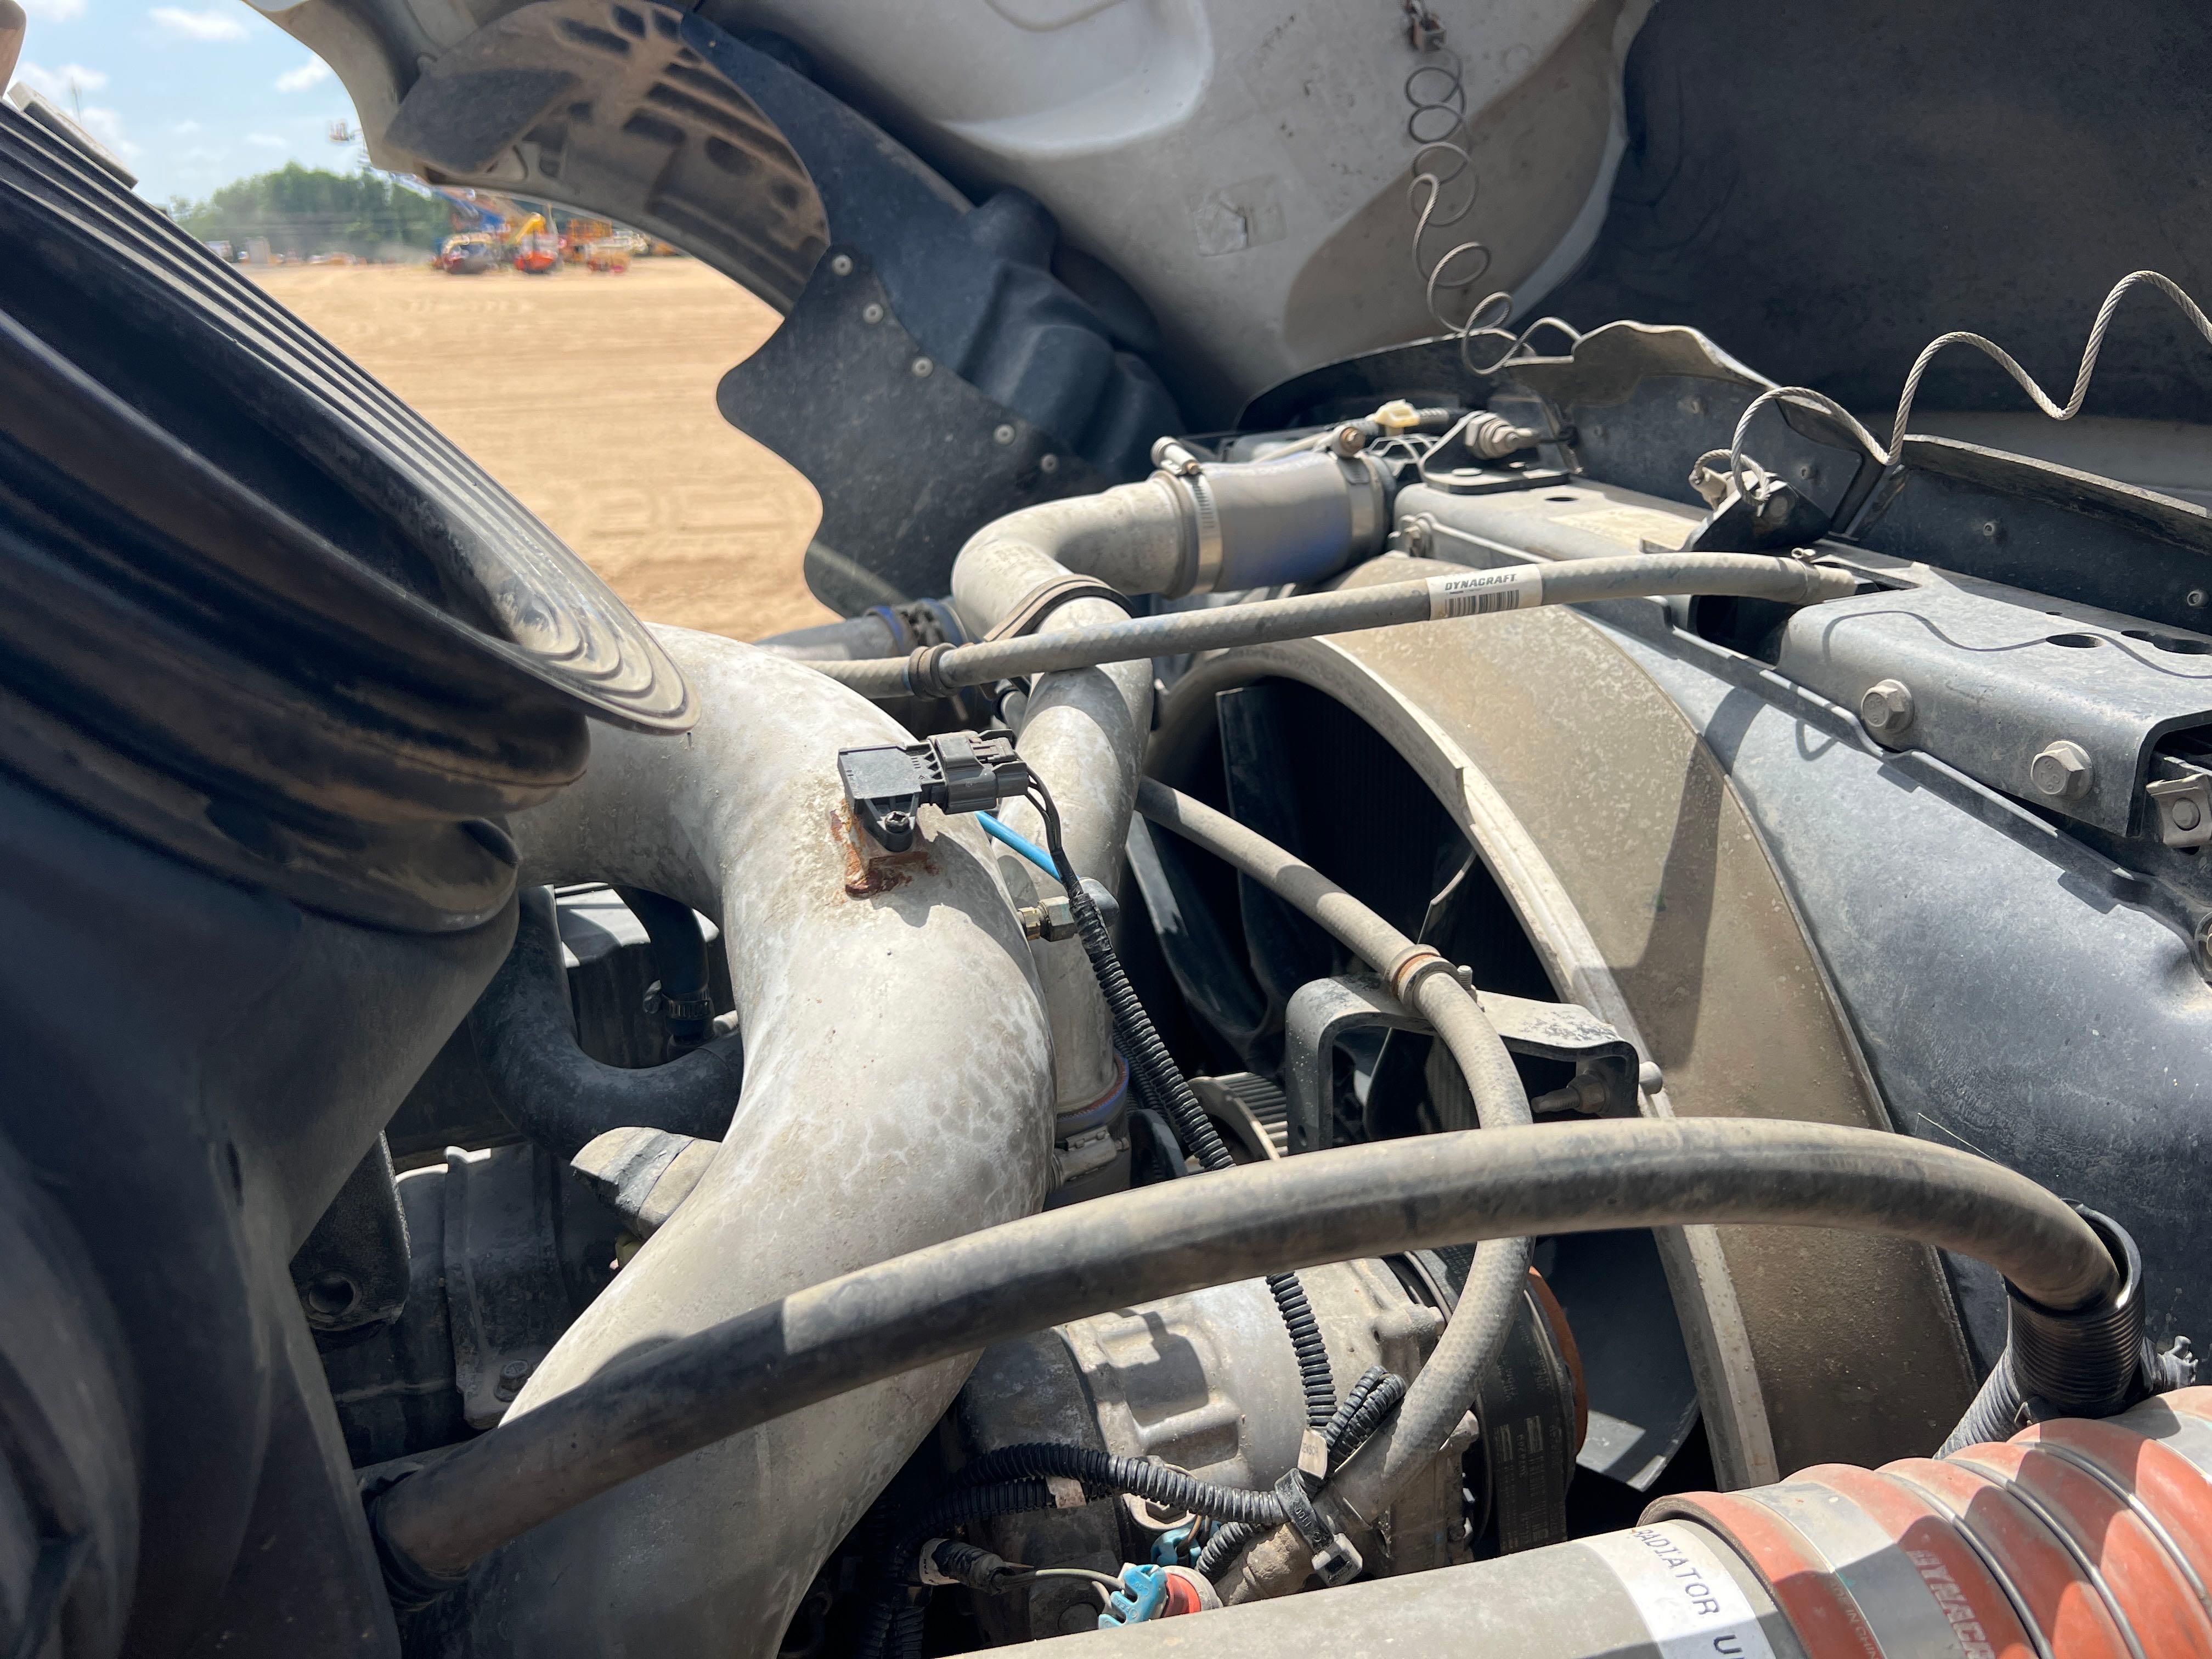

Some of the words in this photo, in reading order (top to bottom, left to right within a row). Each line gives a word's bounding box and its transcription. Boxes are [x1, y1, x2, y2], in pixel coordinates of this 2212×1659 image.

[1445, 574, 1516, 590] DYNACRAFT
[1630, 1530, 1720, 1615] RADIATOR
[1713, 1634, 1745, 1659] U
